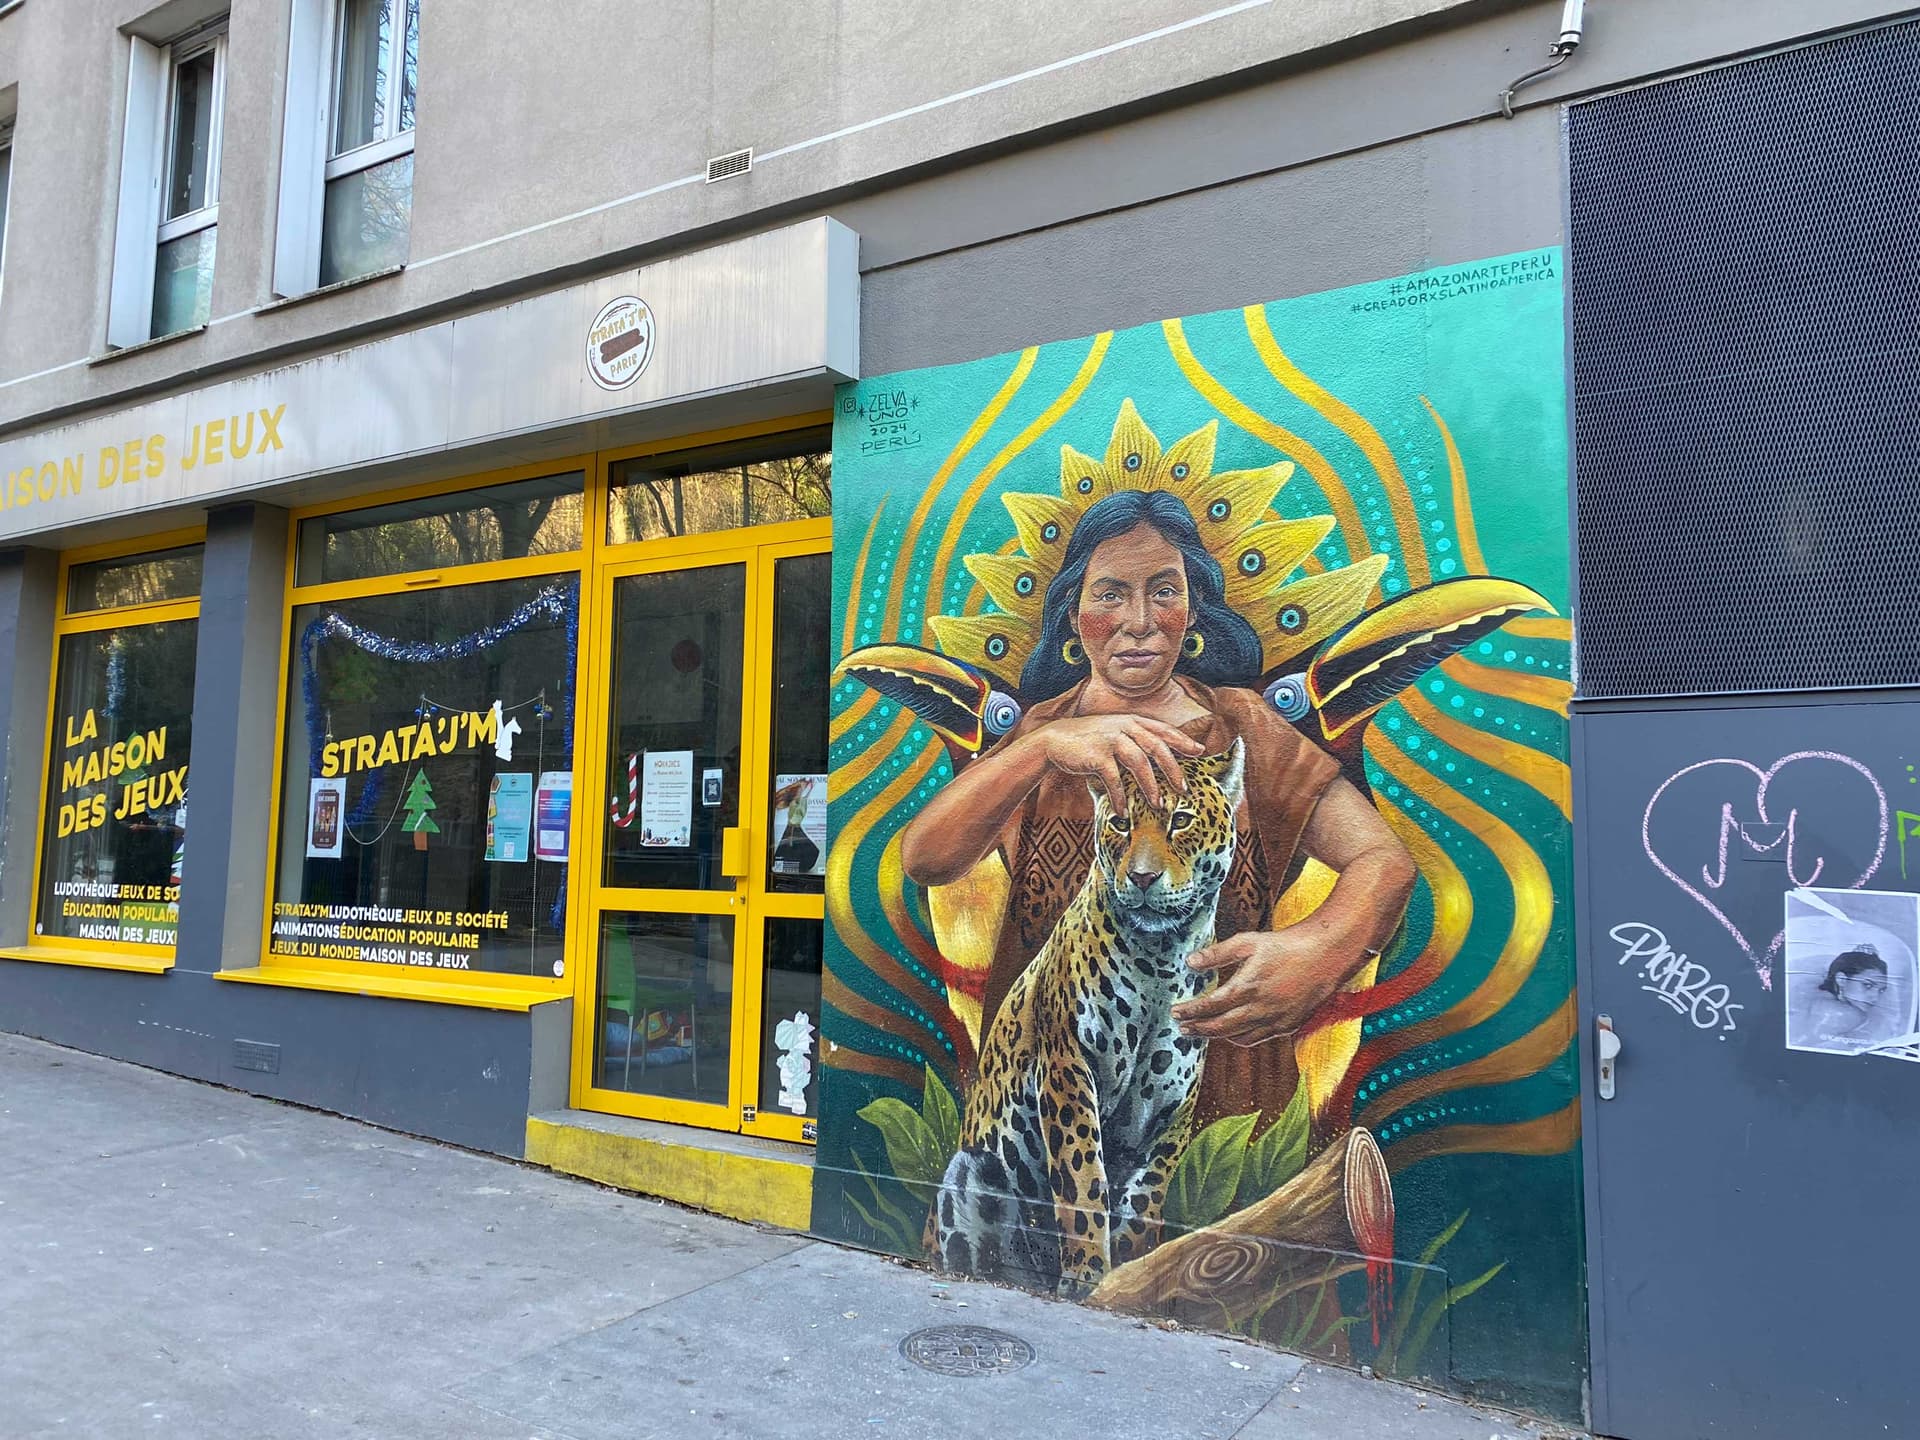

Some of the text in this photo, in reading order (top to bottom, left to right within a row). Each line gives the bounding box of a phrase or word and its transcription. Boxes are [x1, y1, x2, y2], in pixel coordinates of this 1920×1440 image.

[1389, 253, 1552, 296] #AMAZONARTEPERU
[1351, 268, 1555, 313] #CREADORXSLATINOAMERICA
[610, 353, 638, 377] PARIS
[869, 390, 907, 412] ZELVA
[869, 407, 908, 422] UNO
[861, 429, 921, 453] PERÚ
[870, 423, 907, 436] 2024
[0, 404, 286, 512] ISON DES JEUX
[65, 708, 98, 748] LA
[61, 726, 167, 793] MAISON
[57, 765, 189, 839] DES JEUX
[54, 880, 119, 898] LUDOTHÈQUE
[117, 884, 144, 900] JEUX
[147, 886, 162, 900] DE
[63, 899, 179, 923] ÉDUCATION POPULAIR
[329, 904, 403, 923] LUDOTHÈQUE
[402, 909, 433, 925] JEUX
[436, 911, 452, 926] DE
[455, 910, 509, 929] SOCIÉTÉ
[79, 924, 175, 945] MAISON DES JEUX
[272, 921, 479, 949] ANIMATIONS ÉDUCATION POPULAIRE
[271, 940, 470, 969] JEUX DU MONDE MAISON DES JEUX
